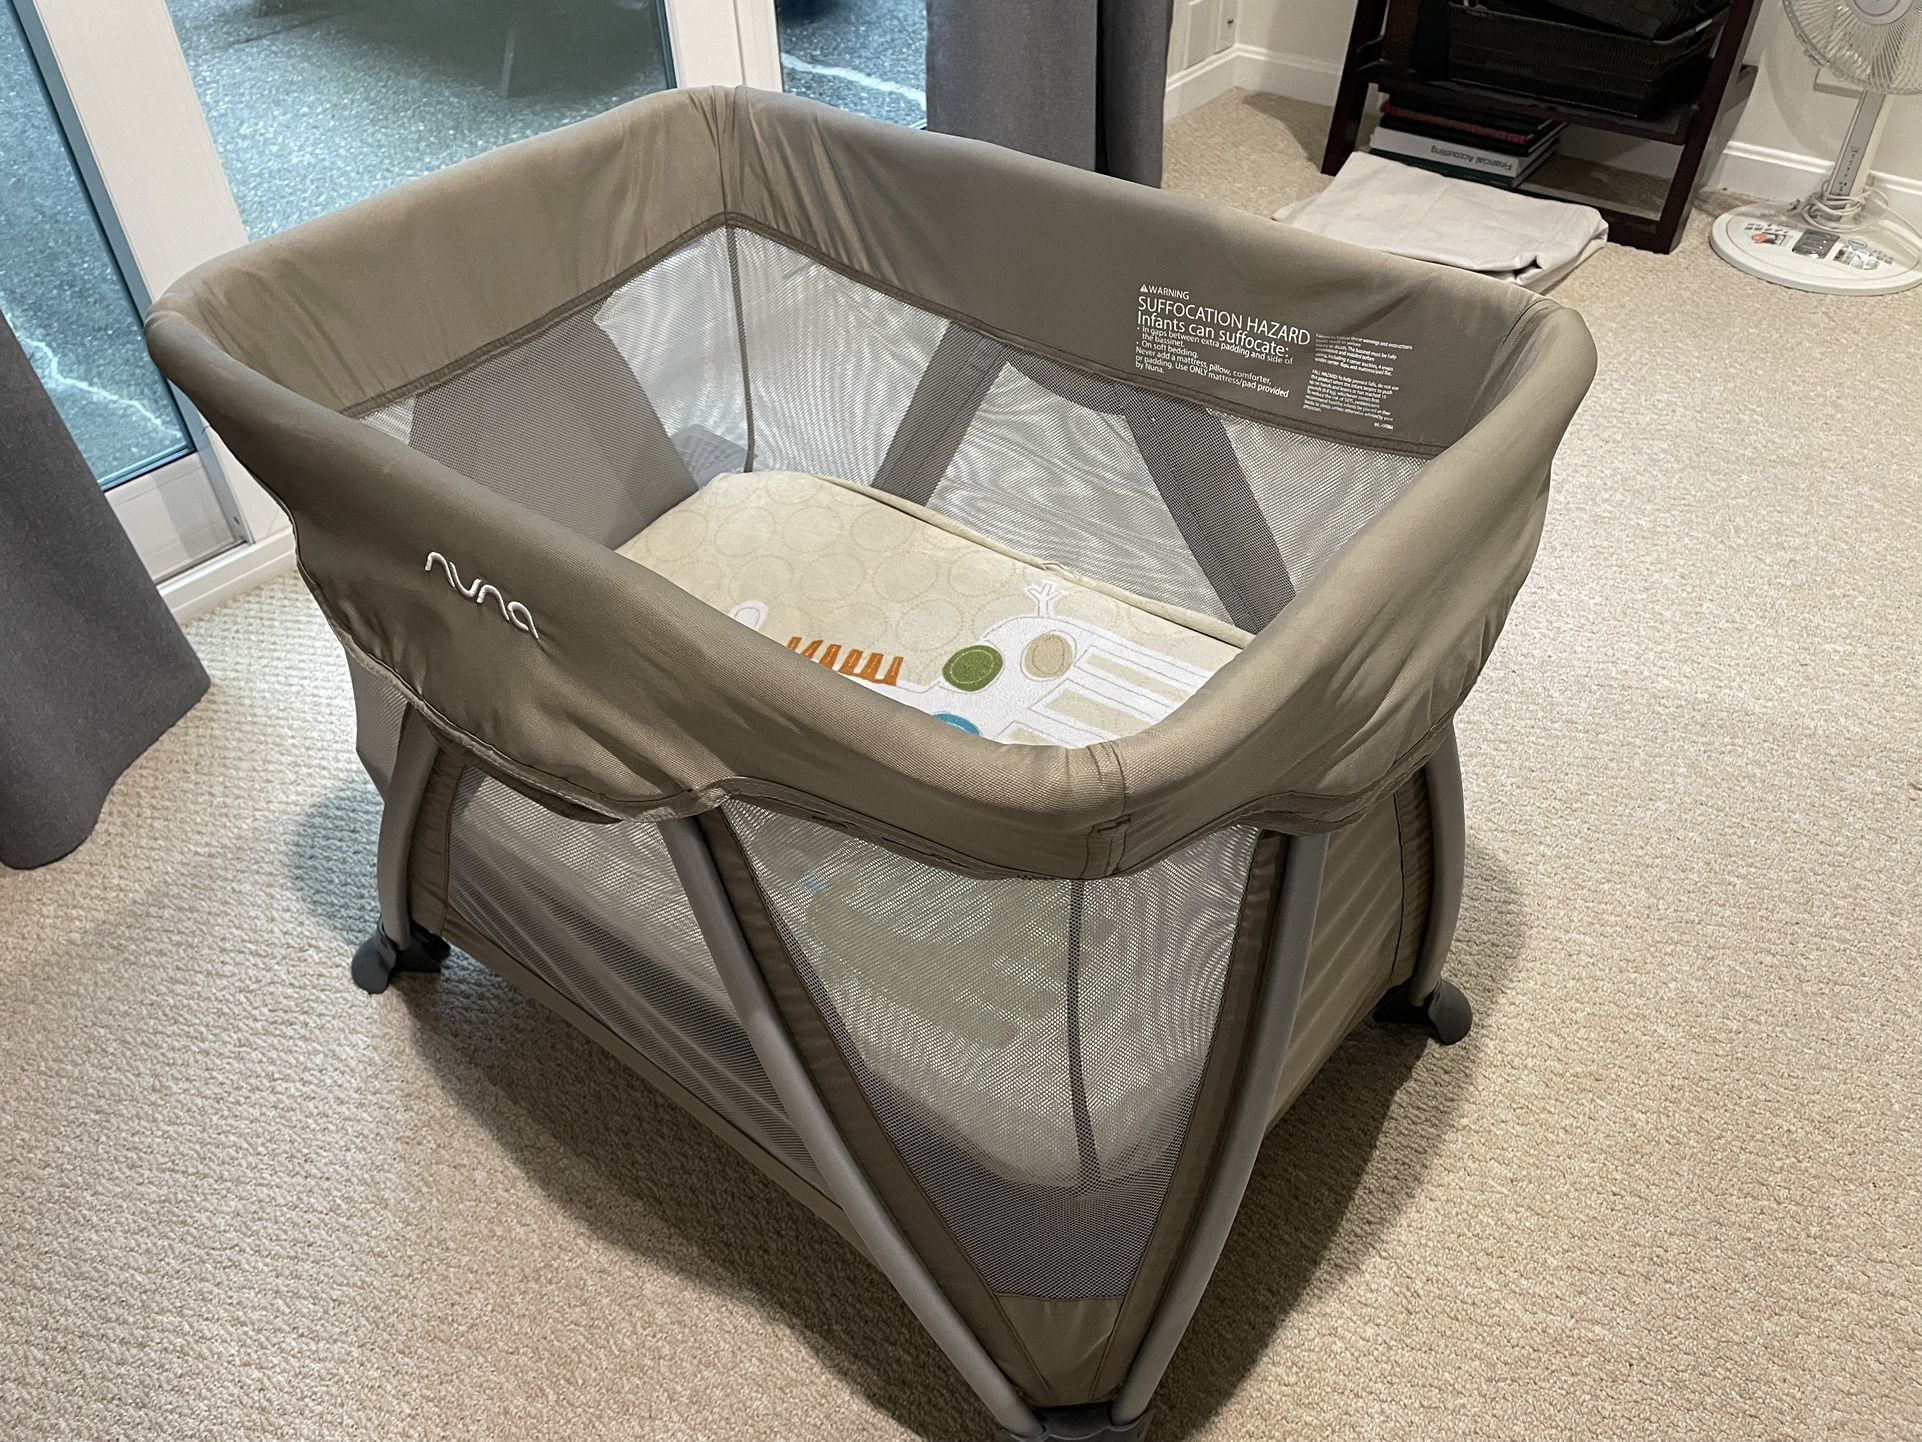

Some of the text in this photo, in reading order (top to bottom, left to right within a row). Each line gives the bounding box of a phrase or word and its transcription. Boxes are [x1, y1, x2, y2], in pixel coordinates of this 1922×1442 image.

[1431, 145, 1512, 170] Financial Accounting
[1149, 285, 1189, 299] WARNING
[1138, 296, 1310, 345] SUFFOCATION HAZARD
[1138, 310, 1185, 332] Infants
[1189, 324, 1214, 339] can
[1219, 330, 1289, 358] suffocate:
[1142, 333, 1184, 348] the bassinet.
[1142, 340, 1199, 359] On soft bedding.
[1150, 328, 1167, 338] gaps
[1169, 331, 1199, 343] between
[1201, 338, 1219, 348] extra
[1221, 343, 1249, 358] padding
[1251, 351, 1265, 361] and
[1267, 354, 1282, 364] side
[1285, 356, 1294, 365] of
[1136, 346, 1156, 357] Never
[1157, 351, 1170, 360] add
[1176, 356, 1208, 370] mattress,
[1209, 363, 1231, 377] pillow,
[1233, 371, 1271, 385] comforter,
[1136, 361, 1165, 374] by Nuna.
[1144, 357, 1174, 370] padding.
[1175, 361, 1189, 372] Use
[1190, 365, 1209, 376] ONLY
[1208, 372, 1256, 389] mattress/pad
[1257, 384, 1289, 398] provided
[425, 551, 540, 639] nuna
